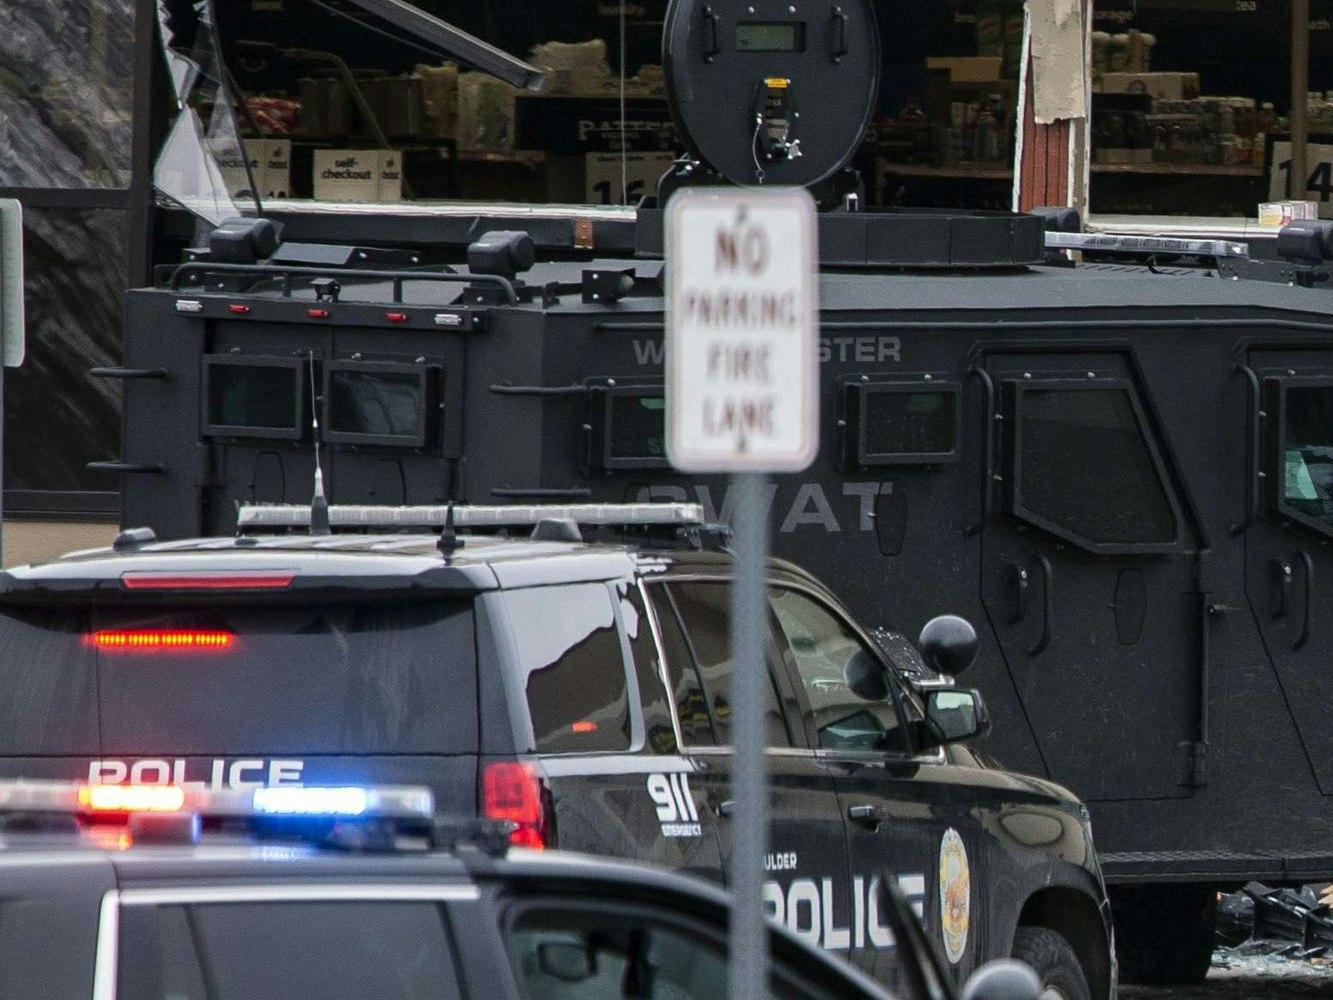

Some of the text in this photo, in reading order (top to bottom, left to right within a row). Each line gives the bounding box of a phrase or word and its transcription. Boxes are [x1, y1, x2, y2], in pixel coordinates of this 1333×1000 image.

[321, 169, 372, 180] checkout
[335, 157, 358, 167] self-
[714, 225, 770, 275] NO
[685, 288, 797, 329] PARKING
[706, 341, 770, 383] FIRE
[702, 398, 776, 438] LANE
[88, 759, 304, 790] POLICE
[647, 772, 699, 821] 911
[763, 852, 798, 870] ULDER
